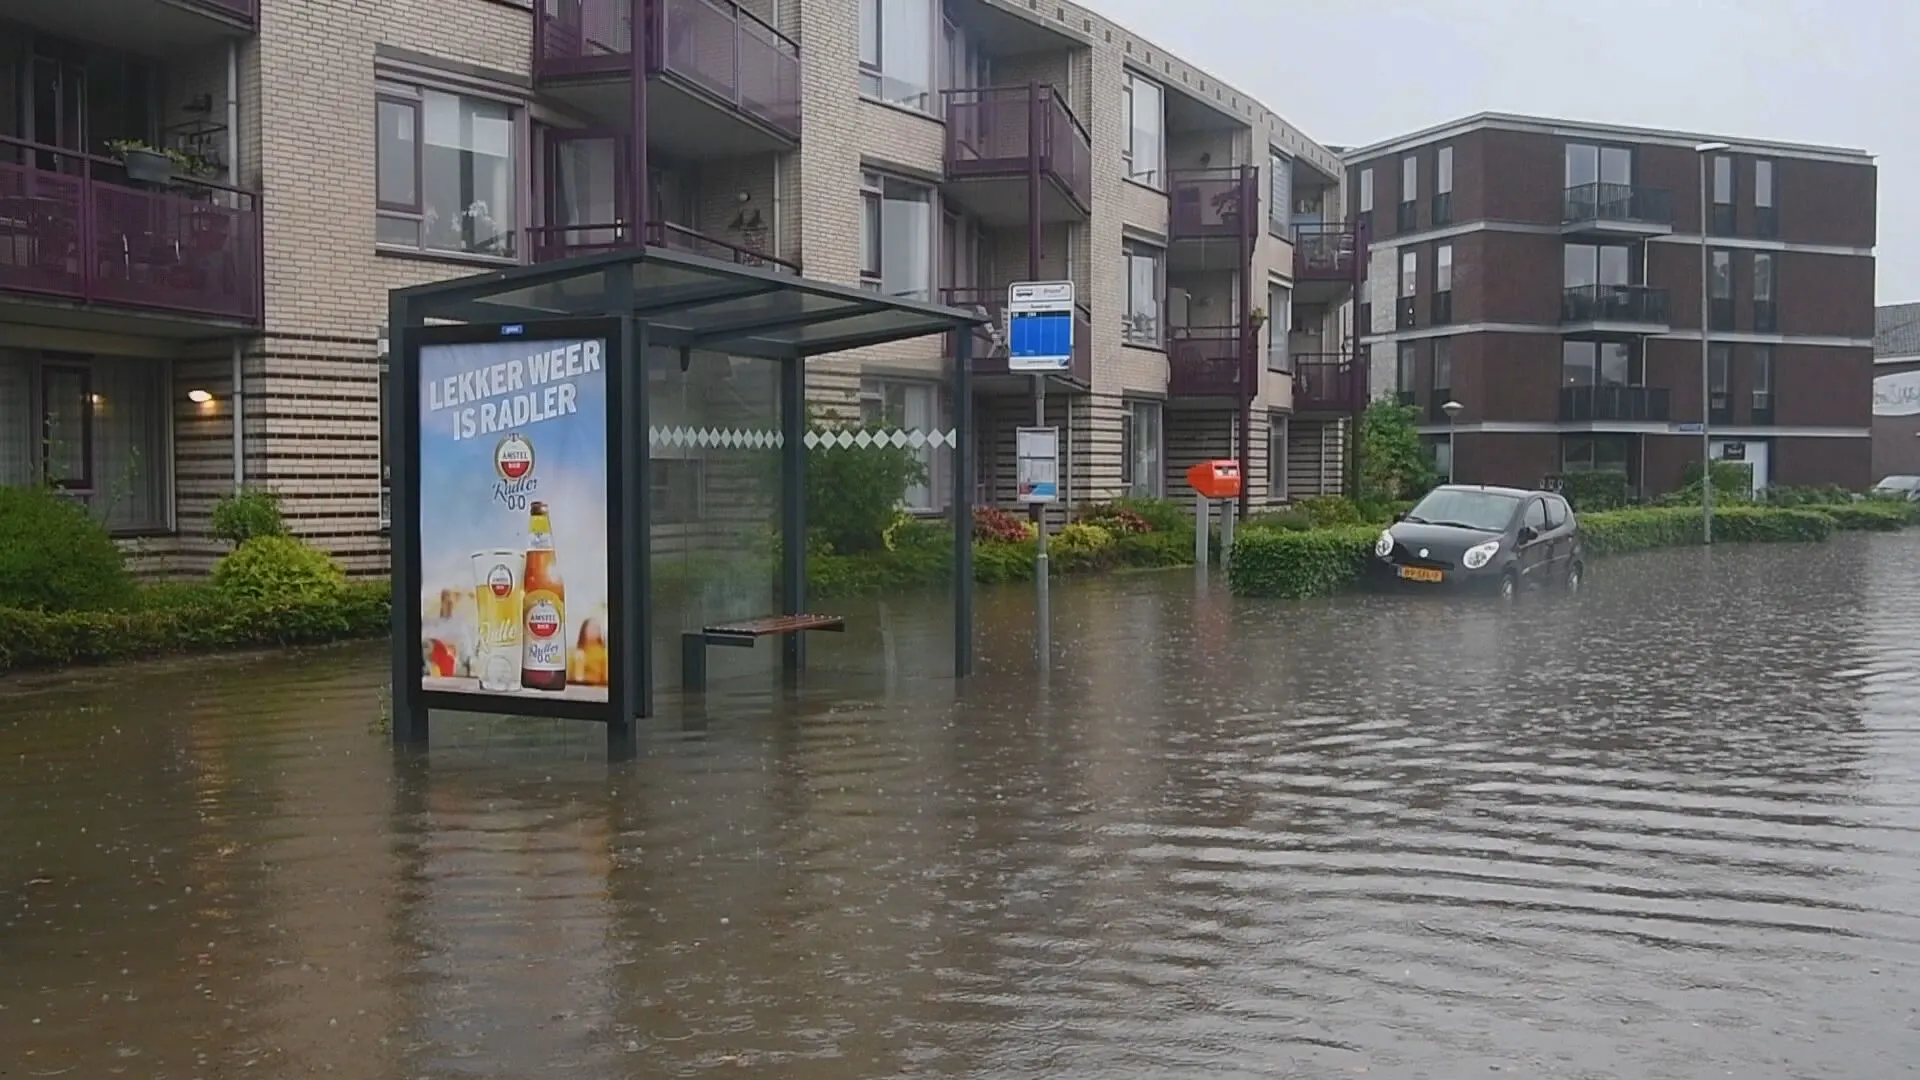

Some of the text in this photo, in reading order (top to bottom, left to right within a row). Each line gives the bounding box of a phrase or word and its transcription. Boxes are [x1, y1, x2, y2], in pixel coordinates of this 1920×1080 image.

[429, 340, 600, 411] LEKKER WEER
[453, 383, 577, 440] IS RADLER
[502, 451, 529, 460] AMSTEL
[492, 476, 538, 502] Radler
